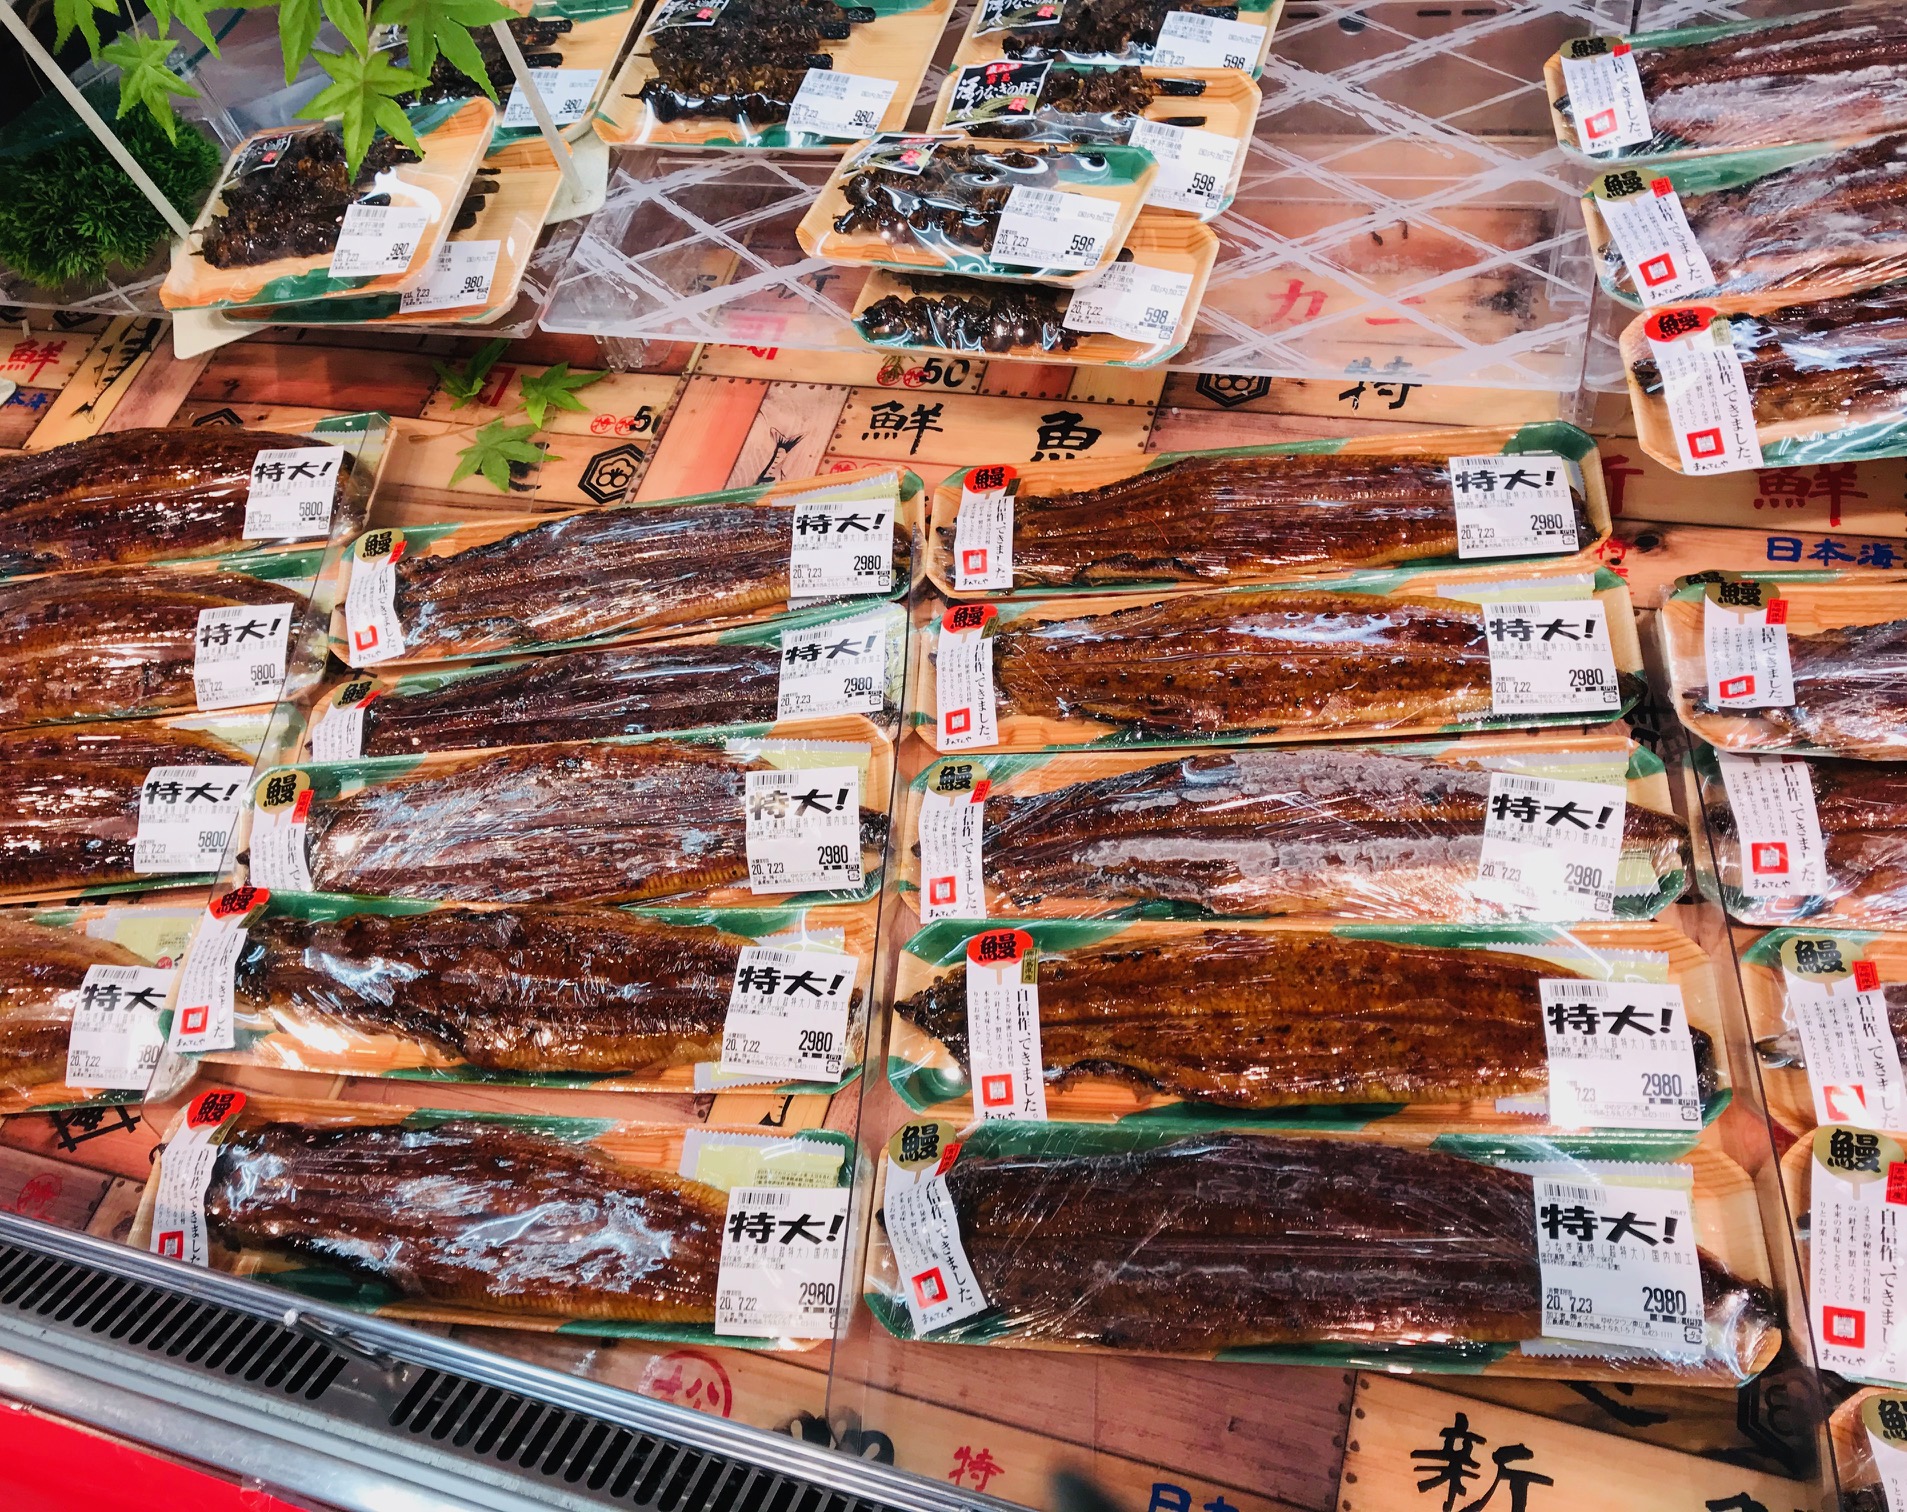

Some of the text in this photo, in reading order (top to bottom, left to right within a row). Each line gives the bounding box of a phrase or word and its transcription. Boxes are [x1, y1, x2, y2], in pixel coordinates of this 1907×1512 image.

[1222, 53, 1247, 70] 598
[562, 98, 583, 111] 980
[852, 109, 875, 123] 980
[1191, 171, 1217, 192] 598
[389, 242, 410, 257] 980
[1069, 233, 1097, 253] 598
[463, 275, 484, 290] 980
[1143, 306, 1170, 325] 598
[299, 501, 324, 517] 5800
[1529, 513, 1564, 532] 2980
[361, 530, 393, 558] 鰻
[1766, 536, 1904, 569] 日本海
[853, 555, 882, 571] 2980
[949, 605, 985, 630] 鰻
[250, 662, 277, 682] 5800
[1568, 667, 1605, 688] 2980
[843, 676, 874, 696] 2980
[935, 764, 973, 792] 鰻
[262, 773, 298, 808] 鰻
[197, 829, 227, 848] 5800
[816, 844, 849, 866] 2980
[1563, 862, 1604, 890] 2980
[977, 931, 1018, 962] 鰻
[1794, 939, 1848, 974] 鰻
[798, 1029, 834, 1053] 2980
[1016, 987, 1039, 1120] 自信作、できました。
[1641, 1072, 1683, 1098] 2980
[191, 1092, 236, 1124] 鰻
[898, 1123, 940, 1163] 鰻
[1826, 1127, 1882, 1174] 鰻
[797, 1282, 836, 1307] 2980
[1641, 1285, 1688, 1317] 2980
[948, 1445, 1006, 1493] 特
